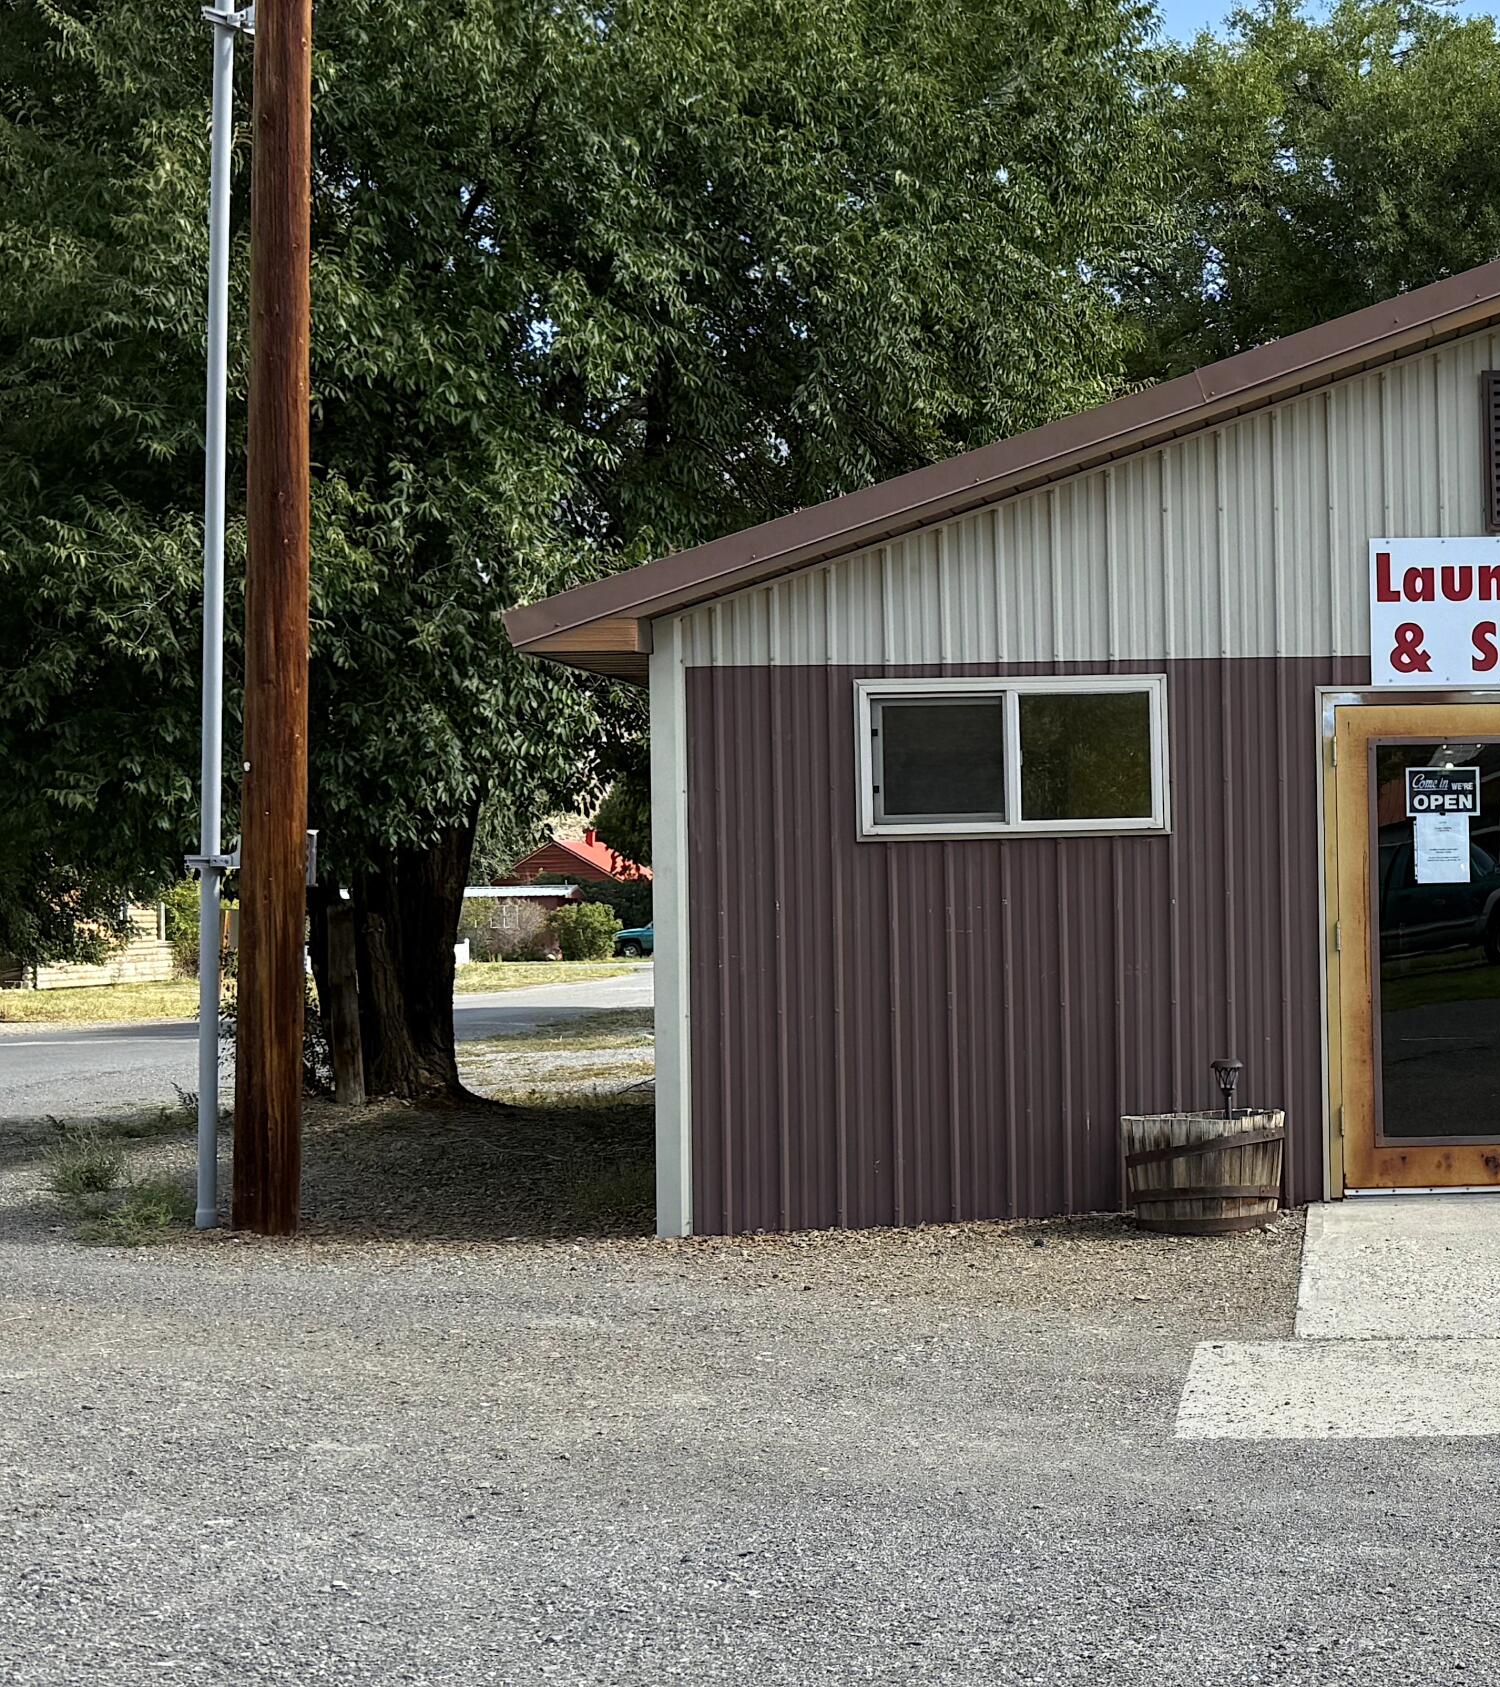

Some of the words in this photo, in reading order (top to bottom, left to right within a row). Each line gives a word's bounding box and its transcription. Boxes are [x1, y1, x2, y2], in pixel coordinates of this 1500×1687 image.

[1389, 622, 1433, 673] &
[1412, 773, 1438, 789] Come
[1451, 782, 1474, 790] WE'RE
[1413, 794, 1473, 810] OPEN
